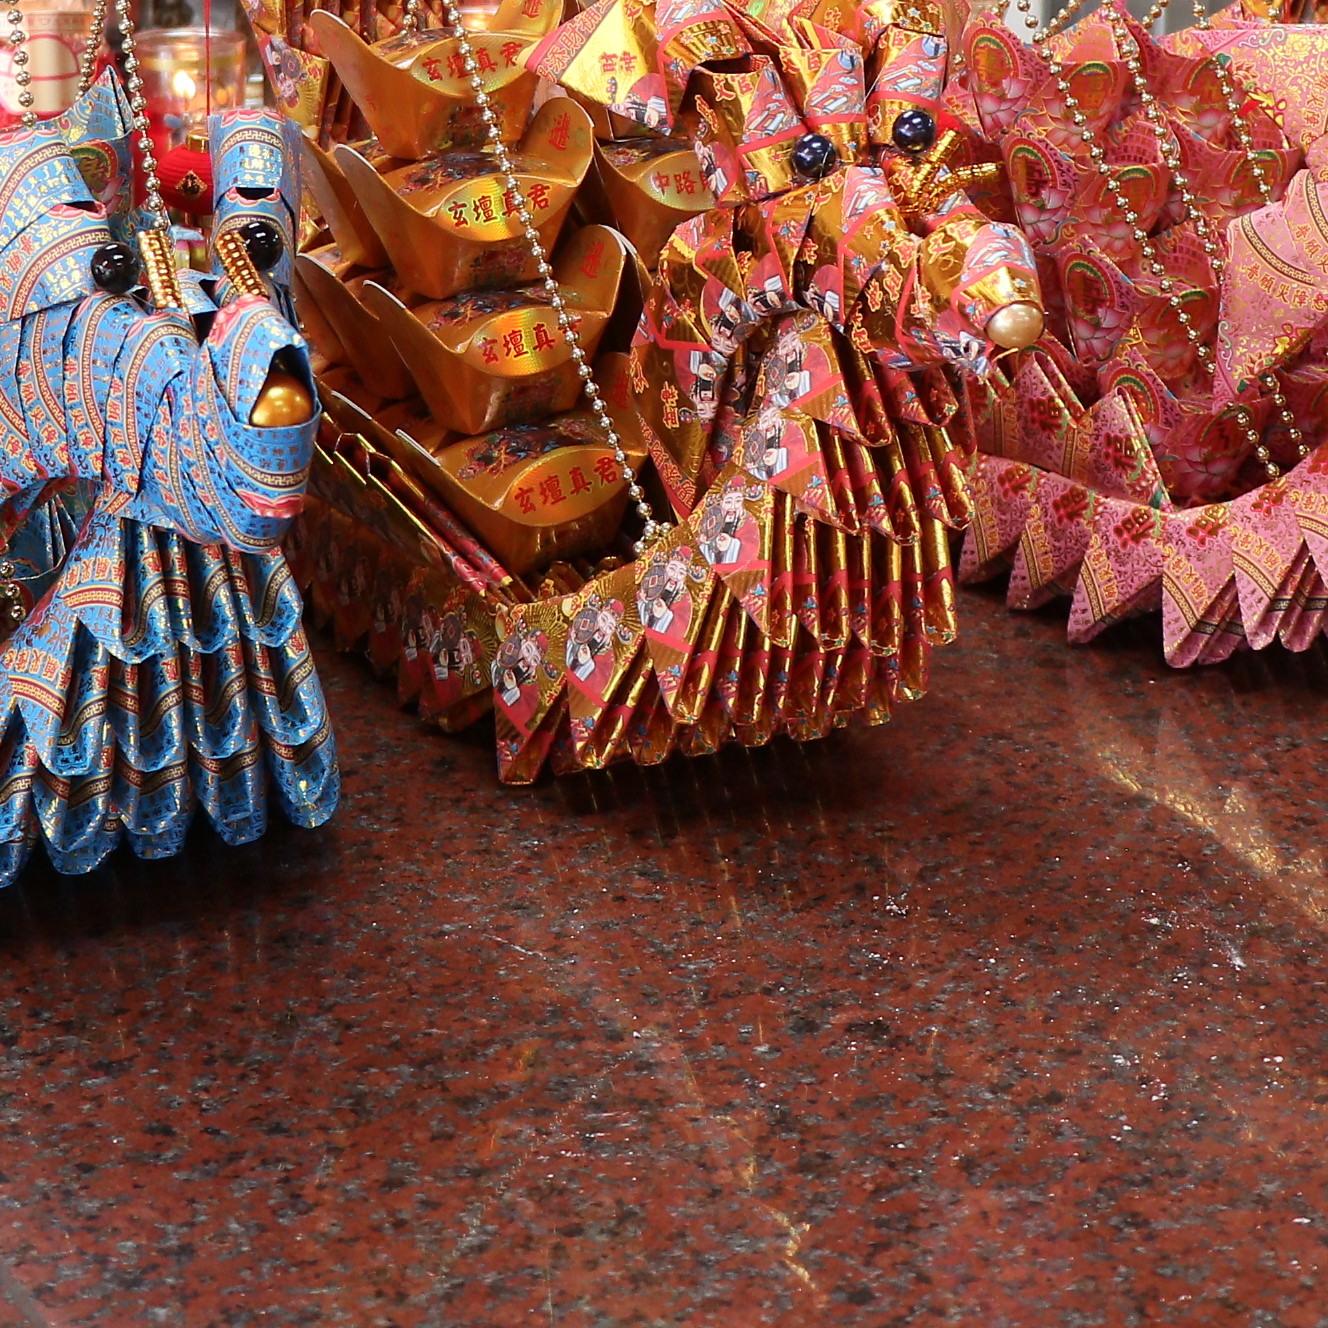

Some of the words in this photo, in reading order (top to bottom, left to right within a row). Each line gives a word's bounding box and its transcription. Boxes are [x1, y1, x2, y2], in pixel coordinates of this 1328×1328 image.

[423, 42, 522, 81] 玄壇真君
[448, 183, 550, 228] 玄壇真君
[514, 457, 619, 515] 玄壇真君
